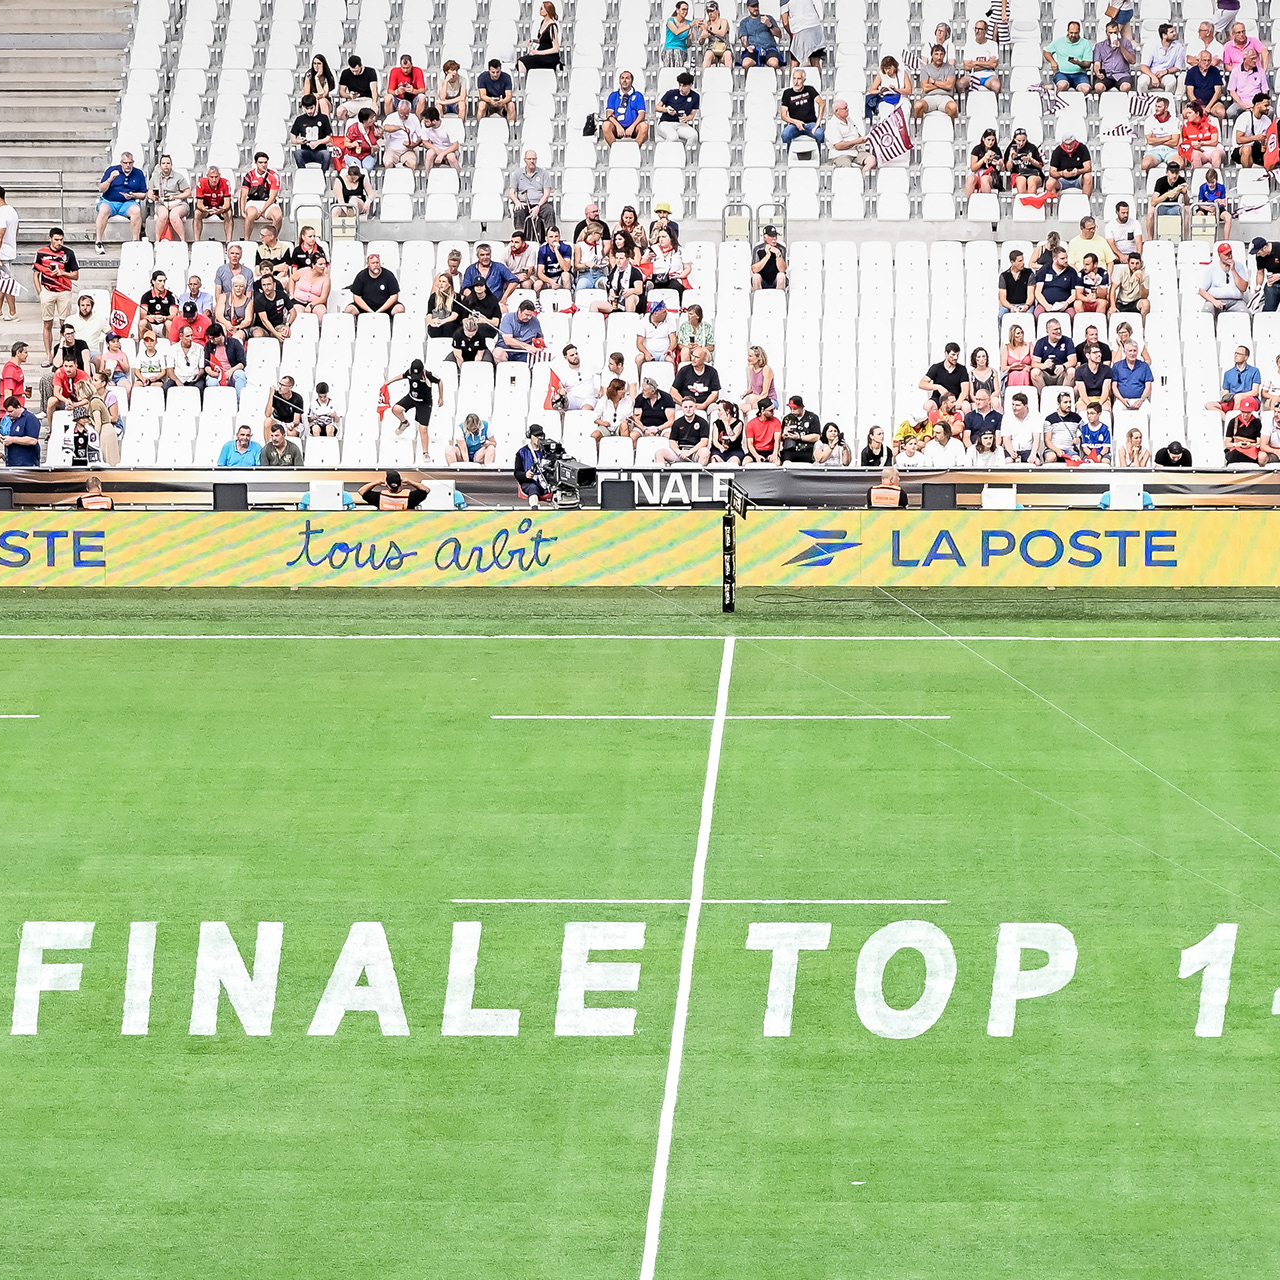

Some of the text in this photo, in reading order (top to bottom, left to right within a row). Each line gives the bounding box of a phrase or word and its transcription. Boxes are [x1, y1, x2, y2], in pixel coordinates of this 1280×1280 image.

[287, 519, 417, 571] tous
[891, 529, 1177, 568] LA POSTE
[10, 921, 648, 1036] FINALE
[746, 919, 1078, 1039] TOP
